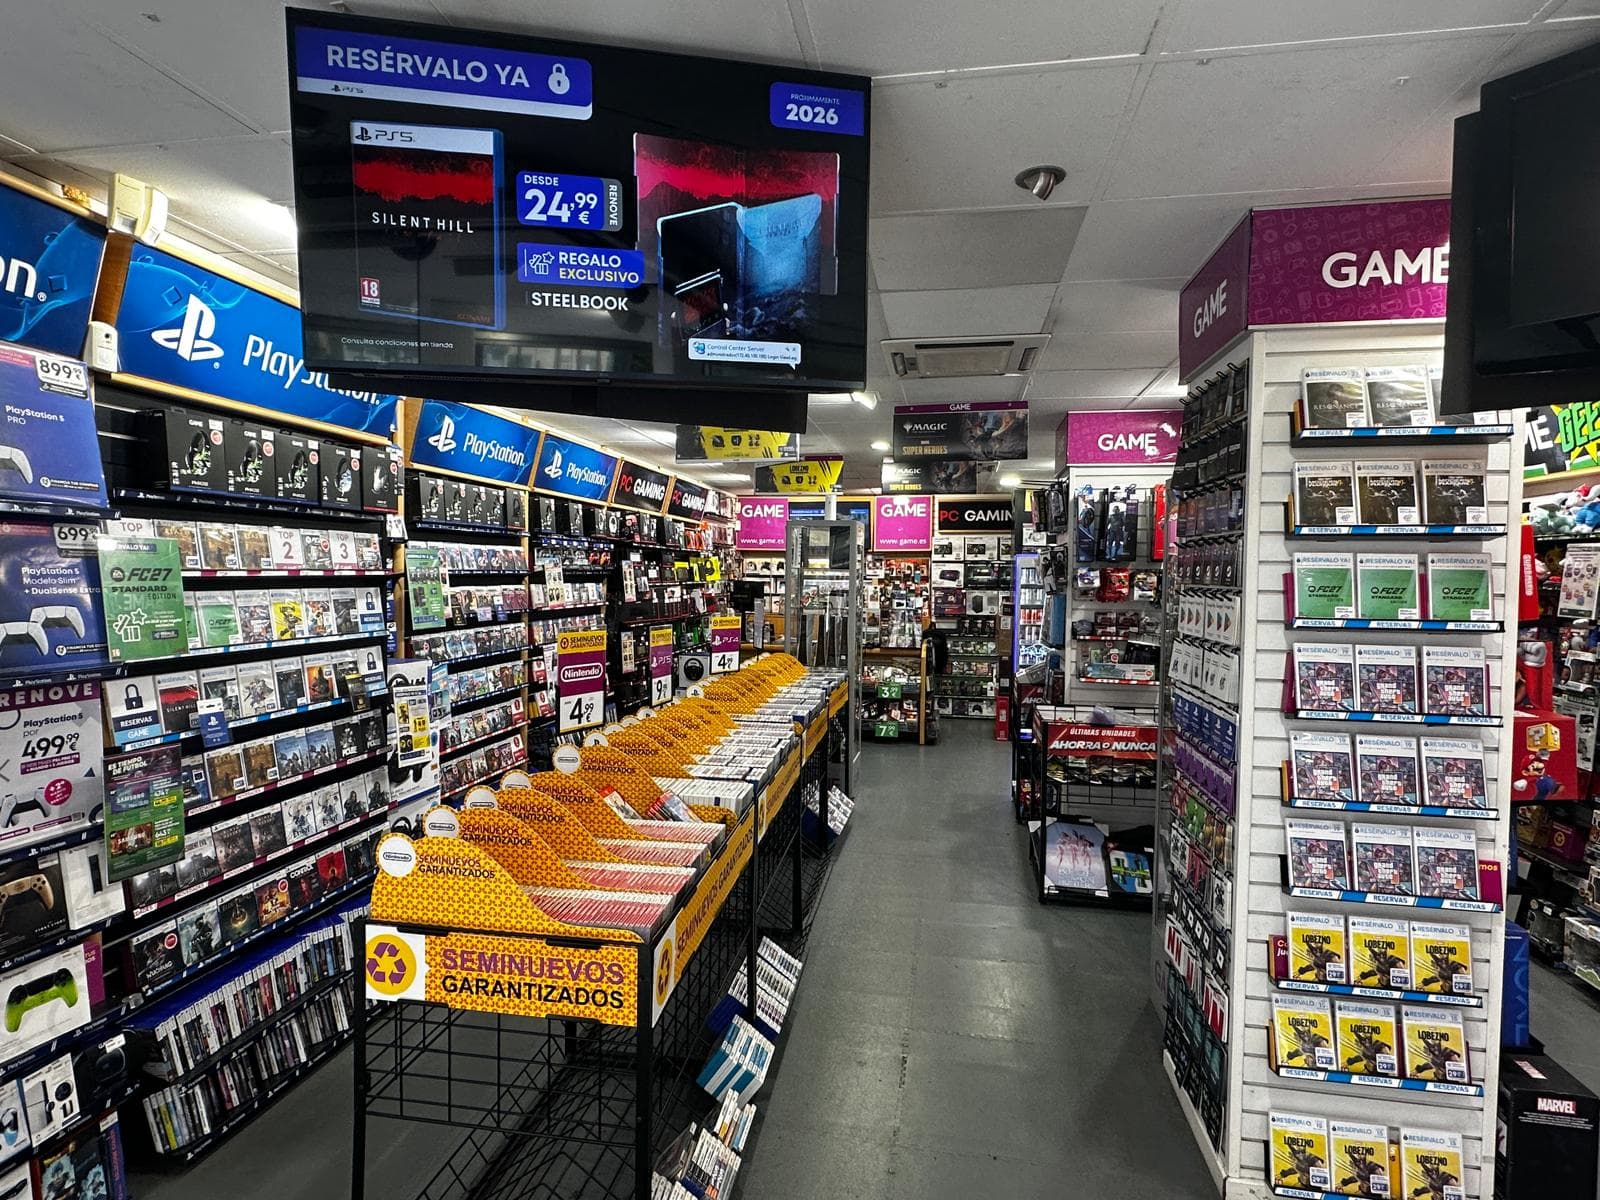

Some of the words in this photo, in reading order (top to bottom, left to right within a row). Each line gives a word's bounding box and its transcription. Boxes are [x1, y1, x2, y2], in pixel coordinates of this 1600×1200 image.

[327, 44, 488, 83] RESÉRVALO
[494, 63, 529, 89] YA
[786, 103, 839, 125] 2026
[375, 129, 414, 143] PS5
[524, 174, 559, 186] DESDE
[608, 184, 618, 226] RENOVE
[372, 211, 431, 229] SILENT
[437, 218, 474, 234] HILL
[558, 251, 621, 268] REGALO
[1321, 246, 1449, 289] GAME
[559, 267, 640, 284] EXCLUSIVO
[362, 280, 379, 297] 18
[531, 291, 629, 311] STEELBOOK
[1193, 279, 1227, 339] GAME
[341, 337, 374, 346] Consulta
[375, 338, 419, 347] condiciones
[5, 404, 58, 421] PlayStation
[949, 403, 971, 411] GAME
[7, 415, 26, 426] PRO
[912, 423, 948, 431] MAGIC
[1097, 433, 1157, 451] GAME
[463, 432, 525, 467] PlayStation
[902, 446, 923, 455] SUPER
[566, 463, 606, 487] PlayStation
[619, 475, 632, 491] PC
[632, 481, 665, 501] GAMING
[673, 489, 681, 505] PC
[681, 492, 705, 510] GAMING
[741, 504, 785, 518] GAME
[880, 503, 927, 518] GAME
[938, 510, 959, 523] PC
[964, 506, 1013, 522] GAMIN
[120, 522, 143, 532] TOP
[278, 530, 294, 539] TOP
[336, 533, 349, 541] TOP
[740, 536, 784, 548] www.game.es
[879, 536, 927, 548] www.game.es
[282, 541, 294, 560] 2
[339, 542, 349, 560] 3
[22, 567, 74, 577] PlayStation
[127, 568, 173, 582] FC27
[23, 577, 57, 585] Modelo
[31, 587, 78, 595] DualSense
[111, 585, 168, 593] STANDARD
[564, 665, 600, 679] Nintendo
[0, 683, 94, 707] RENOVE
[23, 714, 75, 729] PlayStation
[76, 713, 84, 721] 5
[119, 715, 153, 728] RESERVAS
[23, 729, 39, 738] por
[127, 728, 150, 739] GAME
[1069, 726, 1100, 737] ÚLTIMAS
[1101, 729, 1136, 738] UNIDADES
[1050, 740, 1102, 751] AHORRA
[1111, 741, 1157, 751] NUNCA
[581, 757, 627, 767] SEMINUEVOS
[581, 764, 636, 774] GARANTIZADOS
[534, 785, 583, 796] SEMINUEVOS
[500, 803, 553, 815] SEMINUEVOS
[1302, 800, 1336, 808] RESERVAS
[1377, 805, 1411, 813] RESERVAS
[461, 824, 519, 836] SEMINUEVOS
[462, 832, 532, 847] GARANTIZADOS
[418, 854, 481, 868] SEMINUEVOS
[418, 863, 495, 879] GARANTIZADOS
[1299, 889, 1333, 898] RESERVAS
[1373, 895, 1408, 904] RESERVAS
[1450, 902, 1486, 911] RESERVAS
[1295, 915, 1329, 925] RESÉRVALO
[1356, 920, 1394, 929] RESÉRVALO
[1416, 926, 1454, 935] RESÉRVALO
[1301, 933, 1331, 945] LOBEZNO
[1364, 938, 1395, 950] LOBEZNO
[1425, 944, 1457, 956] LOBEZNO
[441, 949, 625, 985] SEMINUEVOS
[441, 975, 625, 1010] GARANTIZADOS
[1359, 988, 1394, 997] RESERVAS
[1435, 995, 1471, 1004] RESERVAS
[1288, 1016, 1318, 1028] LOBEZNO
[1350, 1023, 1380, 1035] LOBEZNO
[1418, 1029, 1449, 1041] LOBEZNO
[1285, 1069, 1319, 1078] RESERVAS
[1358, 1076, 1393, 1085] RESERVAS
[1433, 1083, 1469, 1093] RESERVAS
[1537, 1098, 1576, 1114] MARVEL
[1283, 1136, 1314, 1148] LOBEZNO
[1344, 1145, 1374, 1157] LOBEZNO
[1416, 1154, 1447, 1167] LOBEZNO
[1282, 1188, 1315, 1199] RESERVAS
